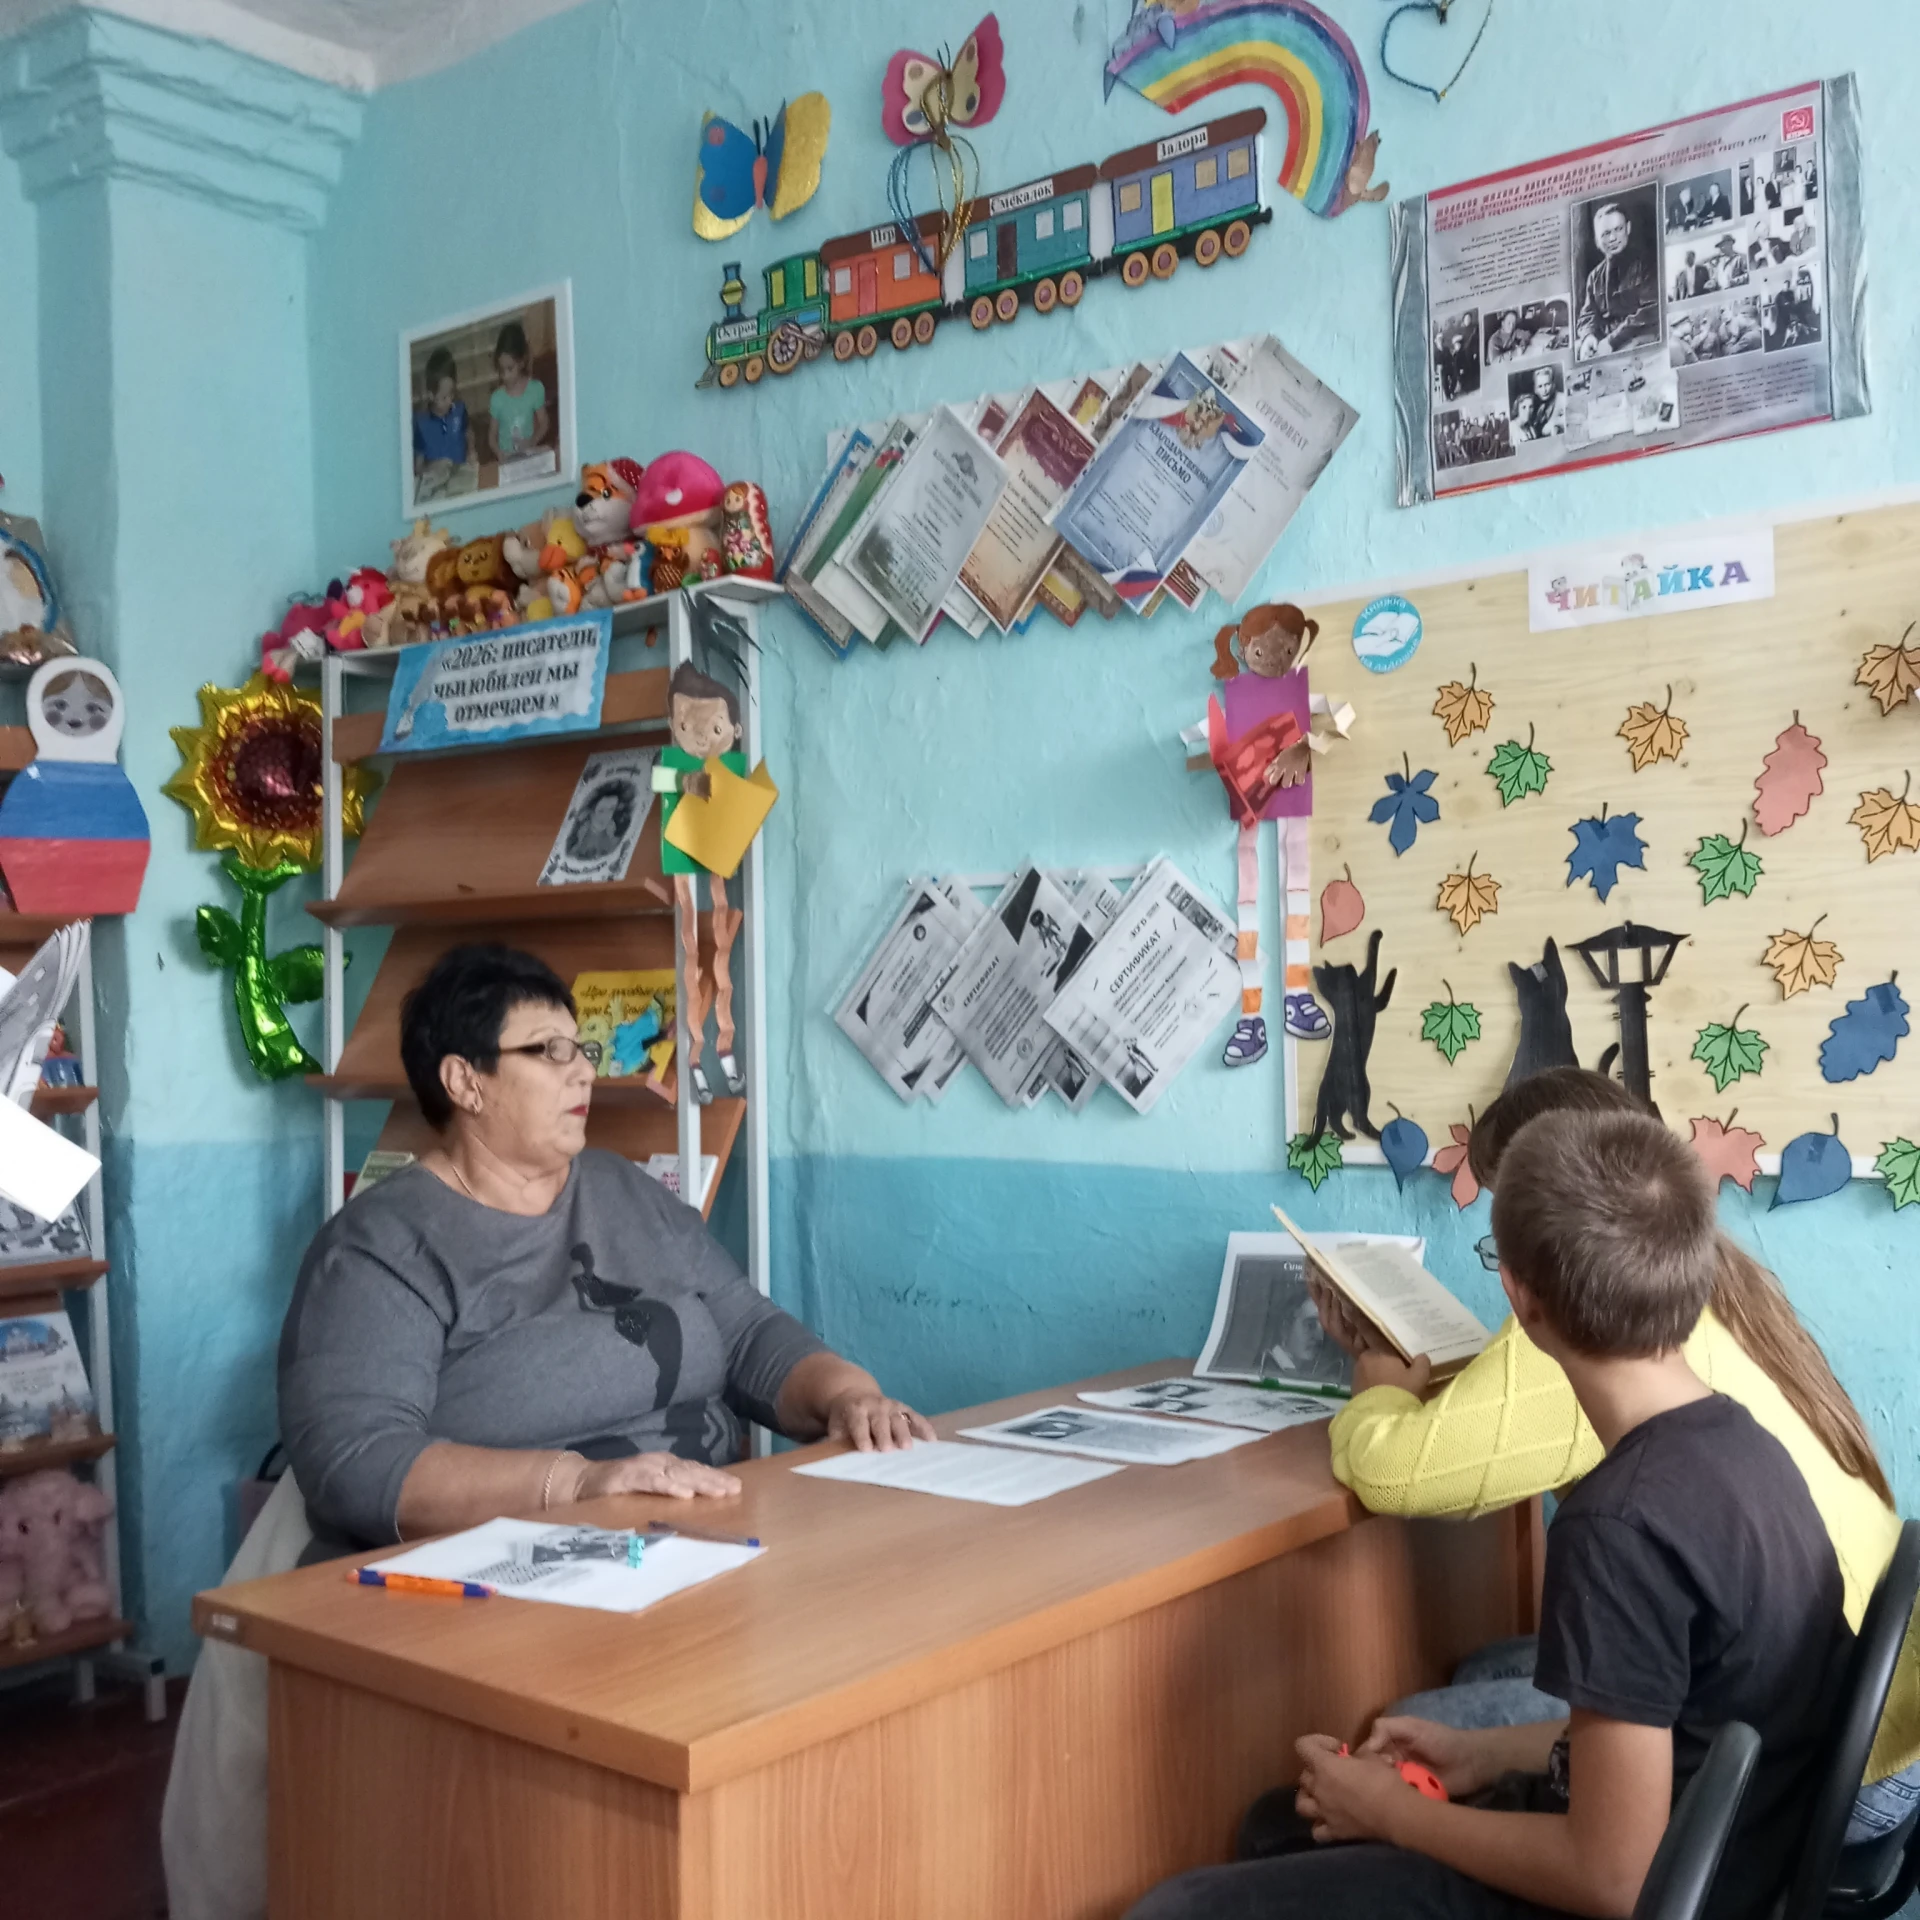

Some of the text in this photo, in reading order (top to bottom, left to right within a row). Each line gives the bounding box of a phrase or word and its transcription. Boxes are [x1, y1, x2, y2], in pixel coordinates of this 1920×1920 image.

[872, 228, 896, 244] Игр
[1155, 445, 1191, 484] ПИСЬМО
[1545, 561, 1750, 612] ЧИТАЙКА
[547, 661, 580, 683] мы
[454, 693, 546, 724] отмечаем
[963, 955, 1000, 1007] СЕРТИФИКАТ
[1109, 929, 1163, 994] СЕРТИФИКАТ
